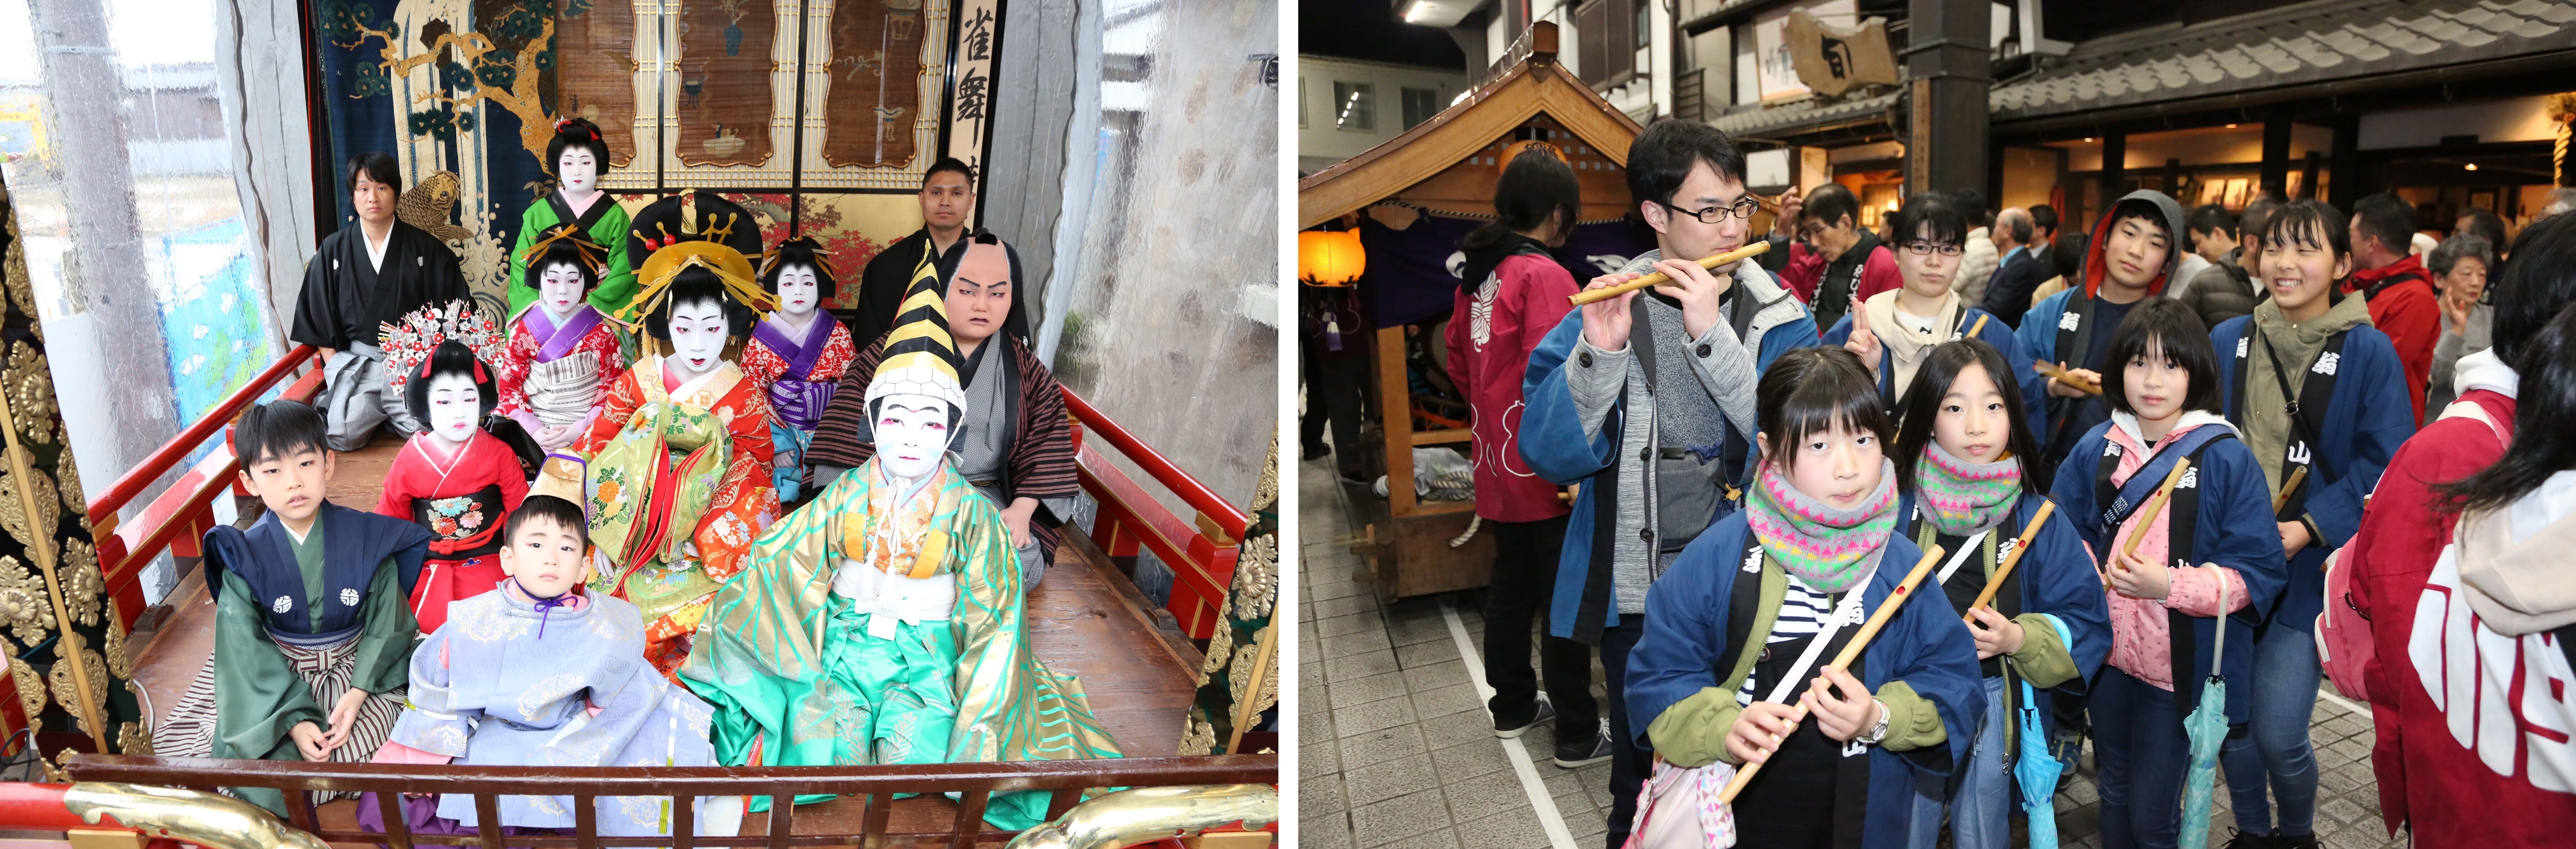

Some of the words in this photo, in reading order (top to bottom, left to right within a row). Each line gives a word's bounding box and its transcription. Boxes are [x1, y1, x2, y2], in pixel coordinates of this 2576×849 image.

[956, 6, 993, 184] 雀舞
[2312, 351, 2340, 375] 翁
[2288, 440, 2311, 465] 山
